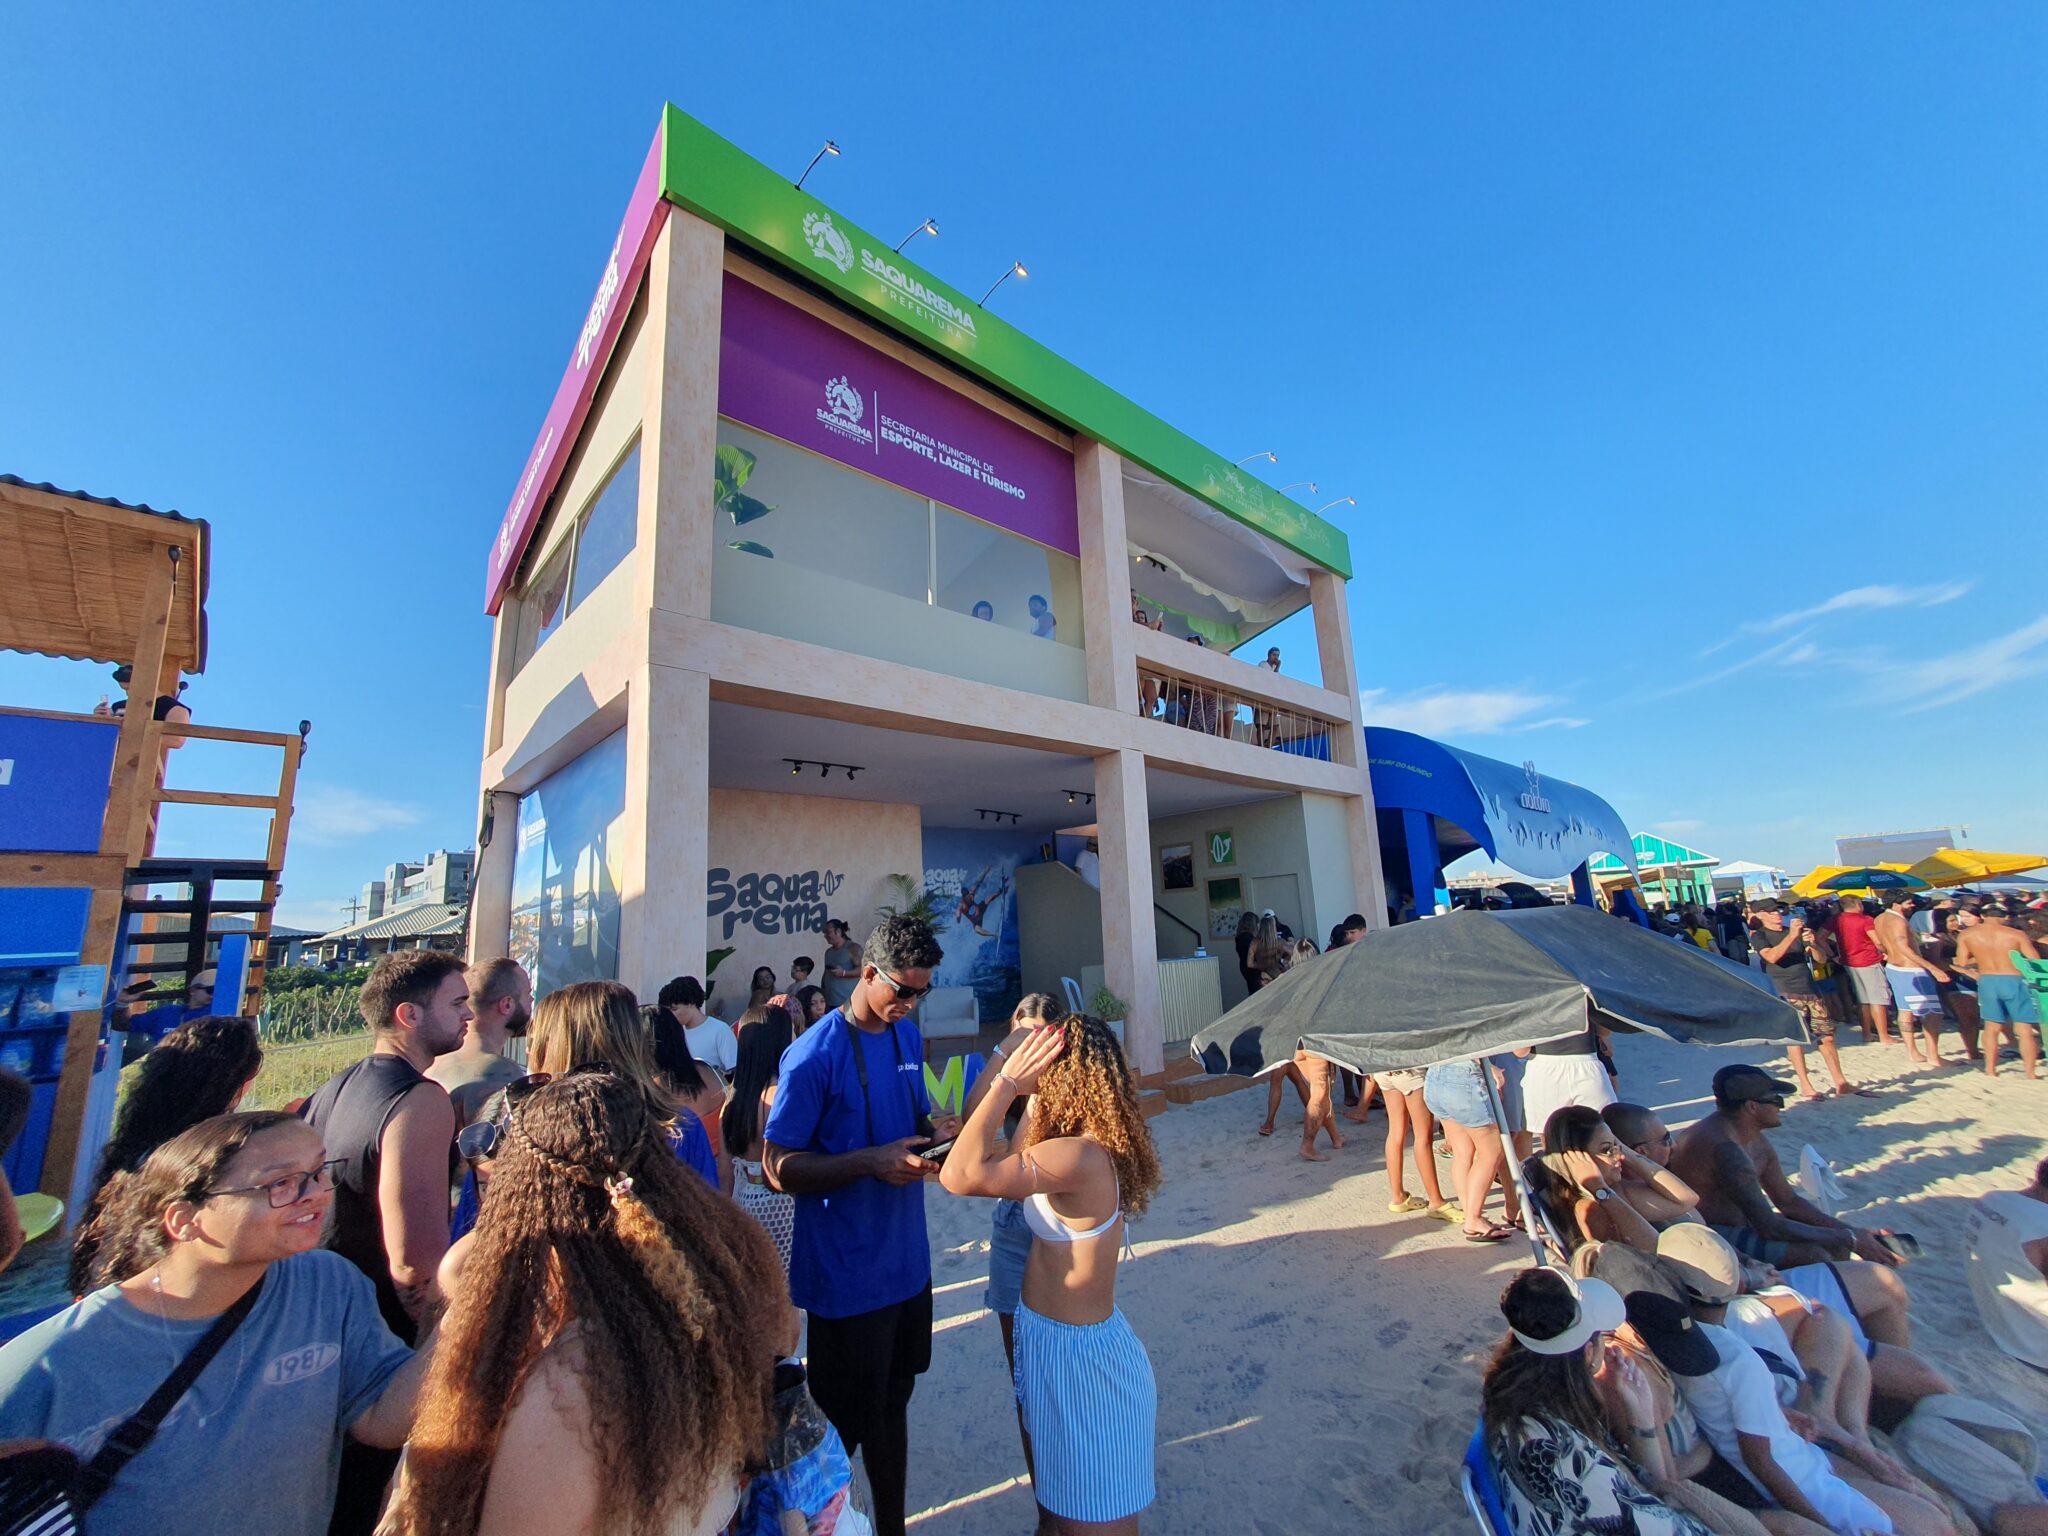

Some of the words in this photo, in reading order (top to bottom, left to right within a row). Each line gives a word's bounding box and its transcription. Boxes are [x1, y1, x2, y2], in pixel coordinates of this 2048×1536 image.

[861, 248, 976, 332] SAQUAREMA
[879, 284, 963, 341] PREFEITURA
[816, 408, 873, 440] SAQUAREMA
[824, 423, 866, 446] PREFEITURA
[880, 414, 936, 448] SECRETARIA
[937, 440, 982, 470] MUNICIPAL
[983, 462, 995, 474] DE
[880, 426, 938, 463] ESPORTE,
[938, 452, 972, 477] LAZER
[973, 469, 981, 481] E
[980, 472, 1027, 501] TURISMO
[707, 867, 821, 918] Saqua
[722, 902, 828, 941] rema
[275, 1346, 326, 1382] 1987
